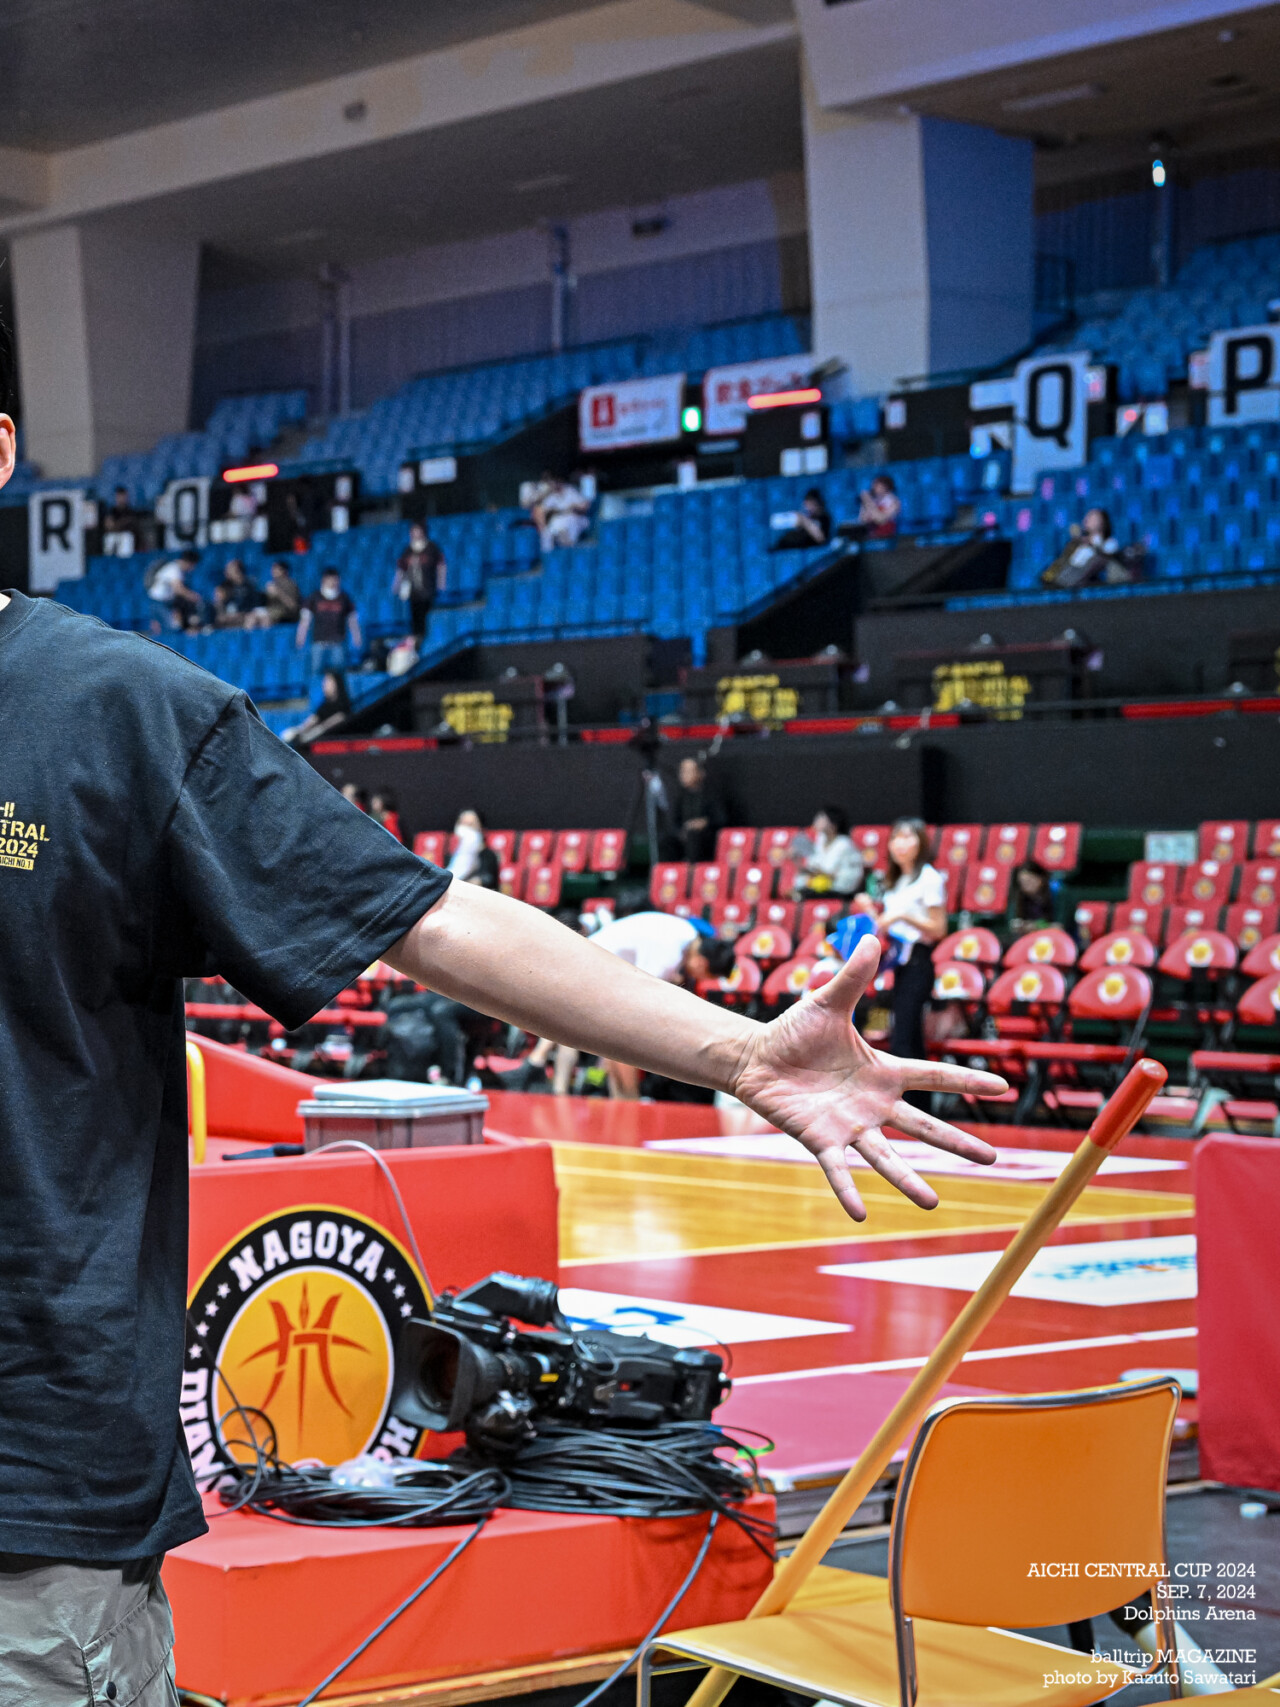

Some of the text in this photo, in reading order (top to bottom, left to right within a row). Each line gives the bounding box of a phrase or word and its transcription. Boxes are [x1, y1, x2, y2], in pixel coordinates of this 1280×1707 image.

[1028, 363, 1074, 448] Q
[1224, 336, 1273, 414] P
[40, 499, 72, 551] R
[228, 1220, 385, 1293] NAGOYA
